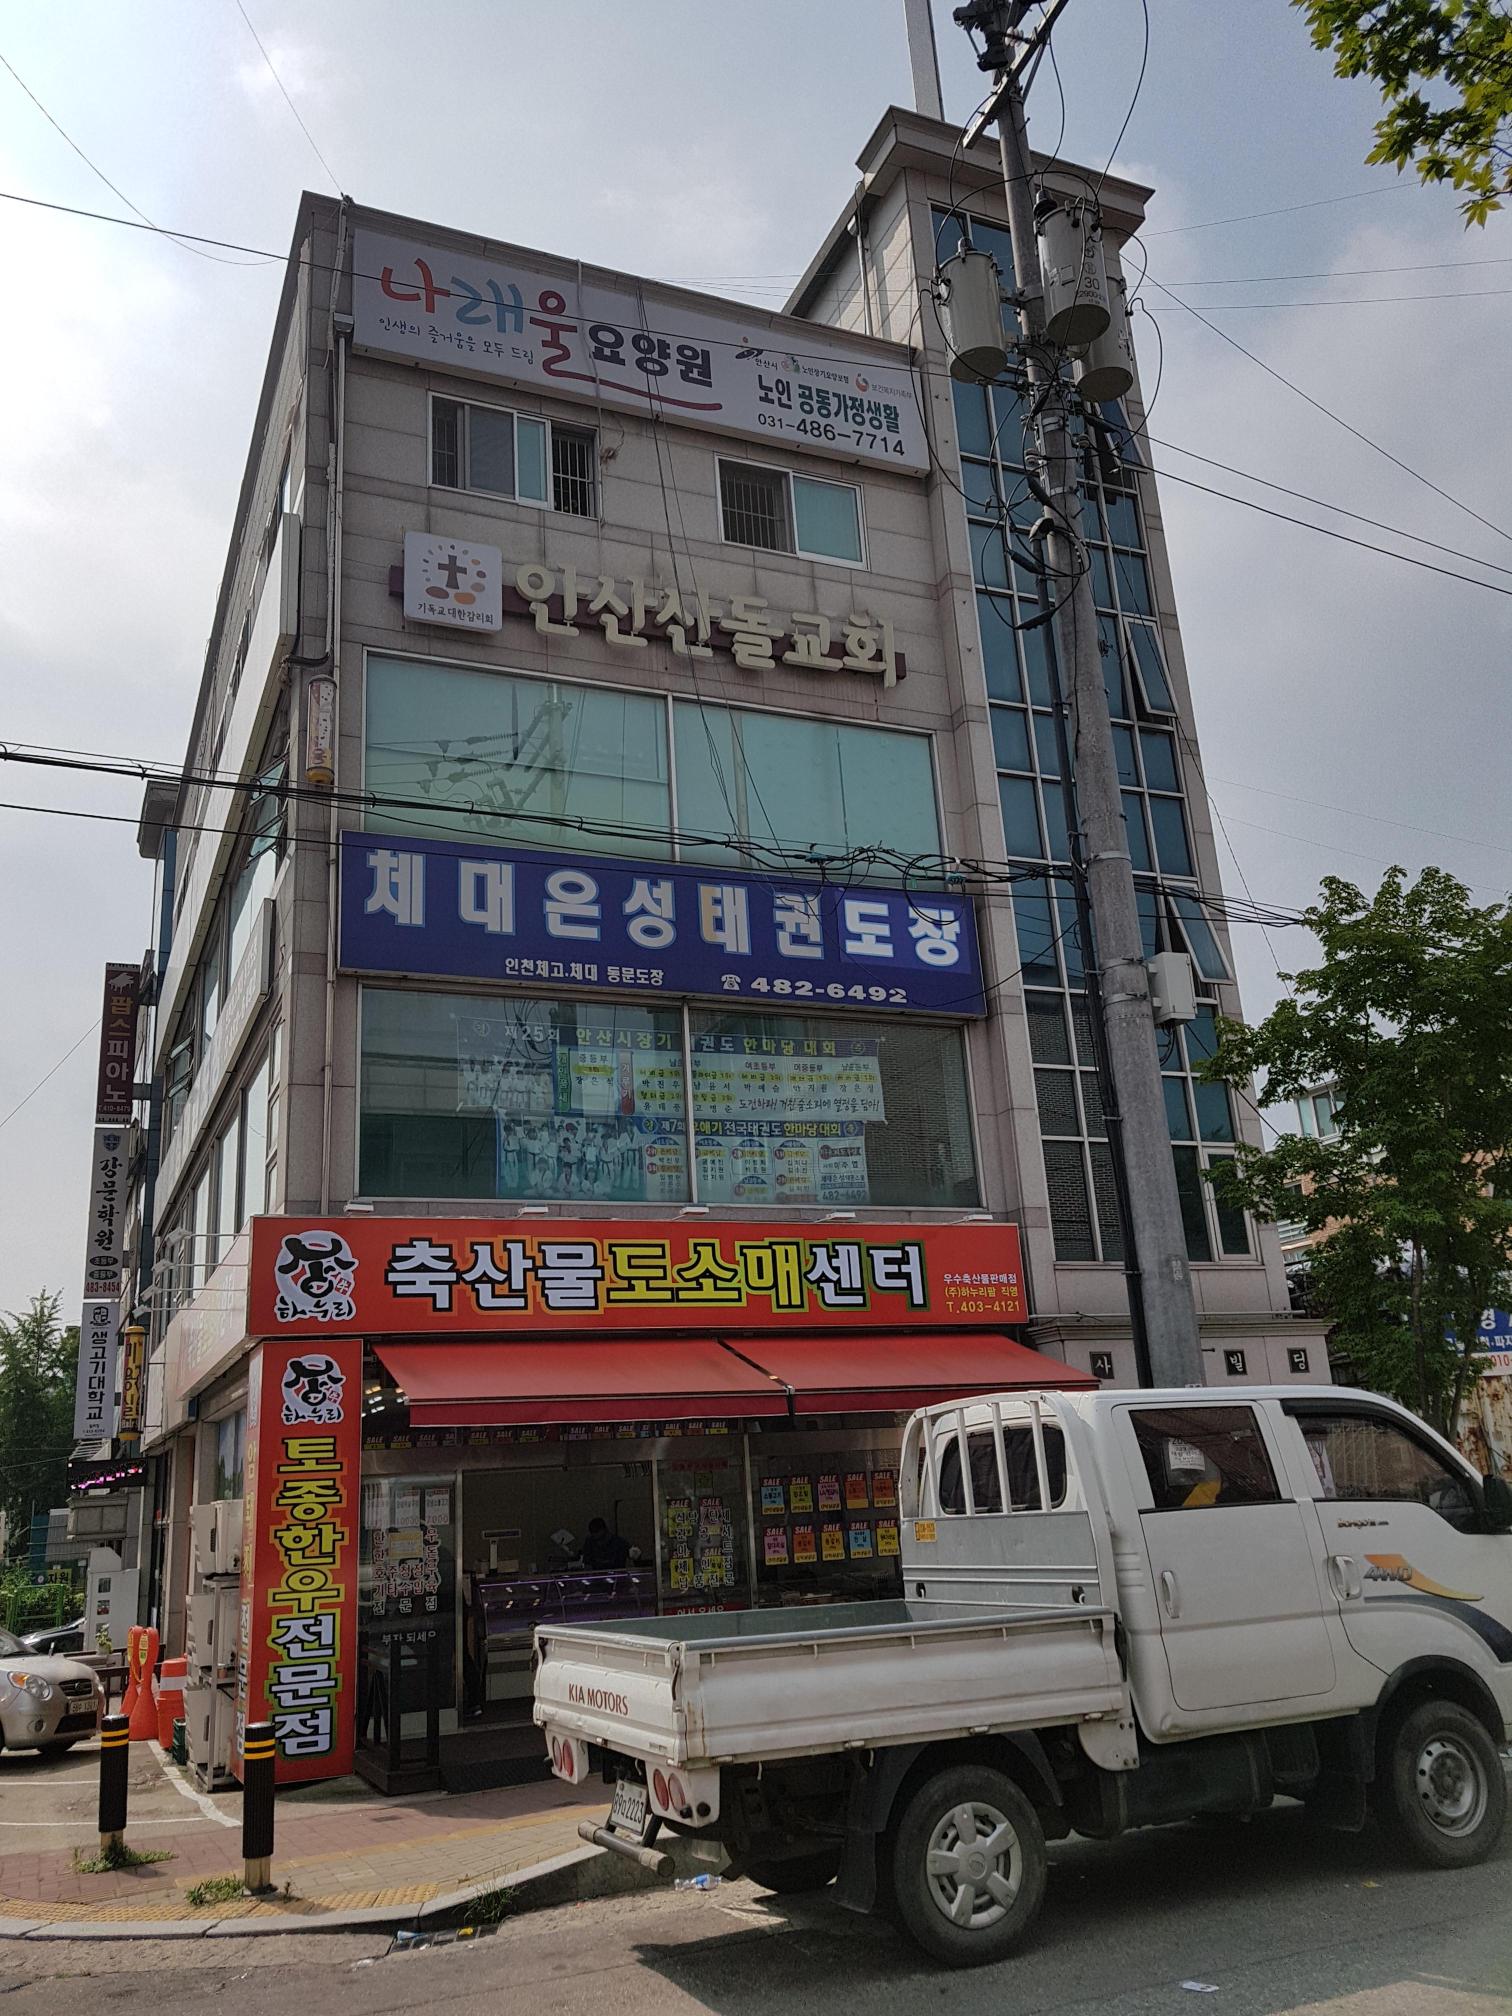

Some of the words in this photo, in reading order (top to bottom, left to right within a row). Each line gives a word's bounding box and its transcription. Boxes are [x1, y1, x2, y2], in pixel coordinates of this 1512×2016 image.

[379, 317, 421, 337] 인생의
[428, 325, 477, 352] 즐거움을
[483, 340, 504, 355] 모두
[511, 346, 535, 365] 드림
[589, 324, 713, 389] 요양원
[755, 357, 778, 372] 안산시
[758, 374, 793, 410] 노인
[798, 383, 900, 434] 공동가정생활
[758, 413, 905, 456] 031-486-7714
[607, 966, 664, 987] 동문도장
[751, 977, 908, 1004] 482-6492
[576, 1028, 672, 1050] 안산시장기
[743, 1038, 795, 1056] 한마당
[804, 1040, 836, 1057] 대회
[724, 1121, 782, 1136] 전국태권도
[783, 1121, 818, 1137] 한마당
[820, 1121, 841, 1137] 대회
[943, 1272, 1017, 1285] 우수축산물판매점
[1001, 1286, 1018, 1297] 직영
[946, 1300, 1020, 1314] T.403-4121
[85, 1330, 108, 1421] 생고기대학교
[763, 1478, 781, 1486] SALE
[791, 1476, 809, 1485] SALE
[819, 1474, 837, 1483] SALE
[847, 1473, 864, 1481] SALE
[874, 1472, 891, 1480] SALE
[670, 1500, 689, 1508] SALE
[702, 1498, 720, 1507] SALE
[794, 1525, 812, 1535] SALE
[823, 1523, 841, 1532] SALE
[850, 1522, 868, 1530] SALE
[878, 1520, 896, 1528] SALE
[766, 1527, 785, 1537] SALE
[1363, 1566, 1413, 1582] 4WD
[568, 1683, 586, 1705] KIA
[587, 1690, 629, 1717] MOTORS
